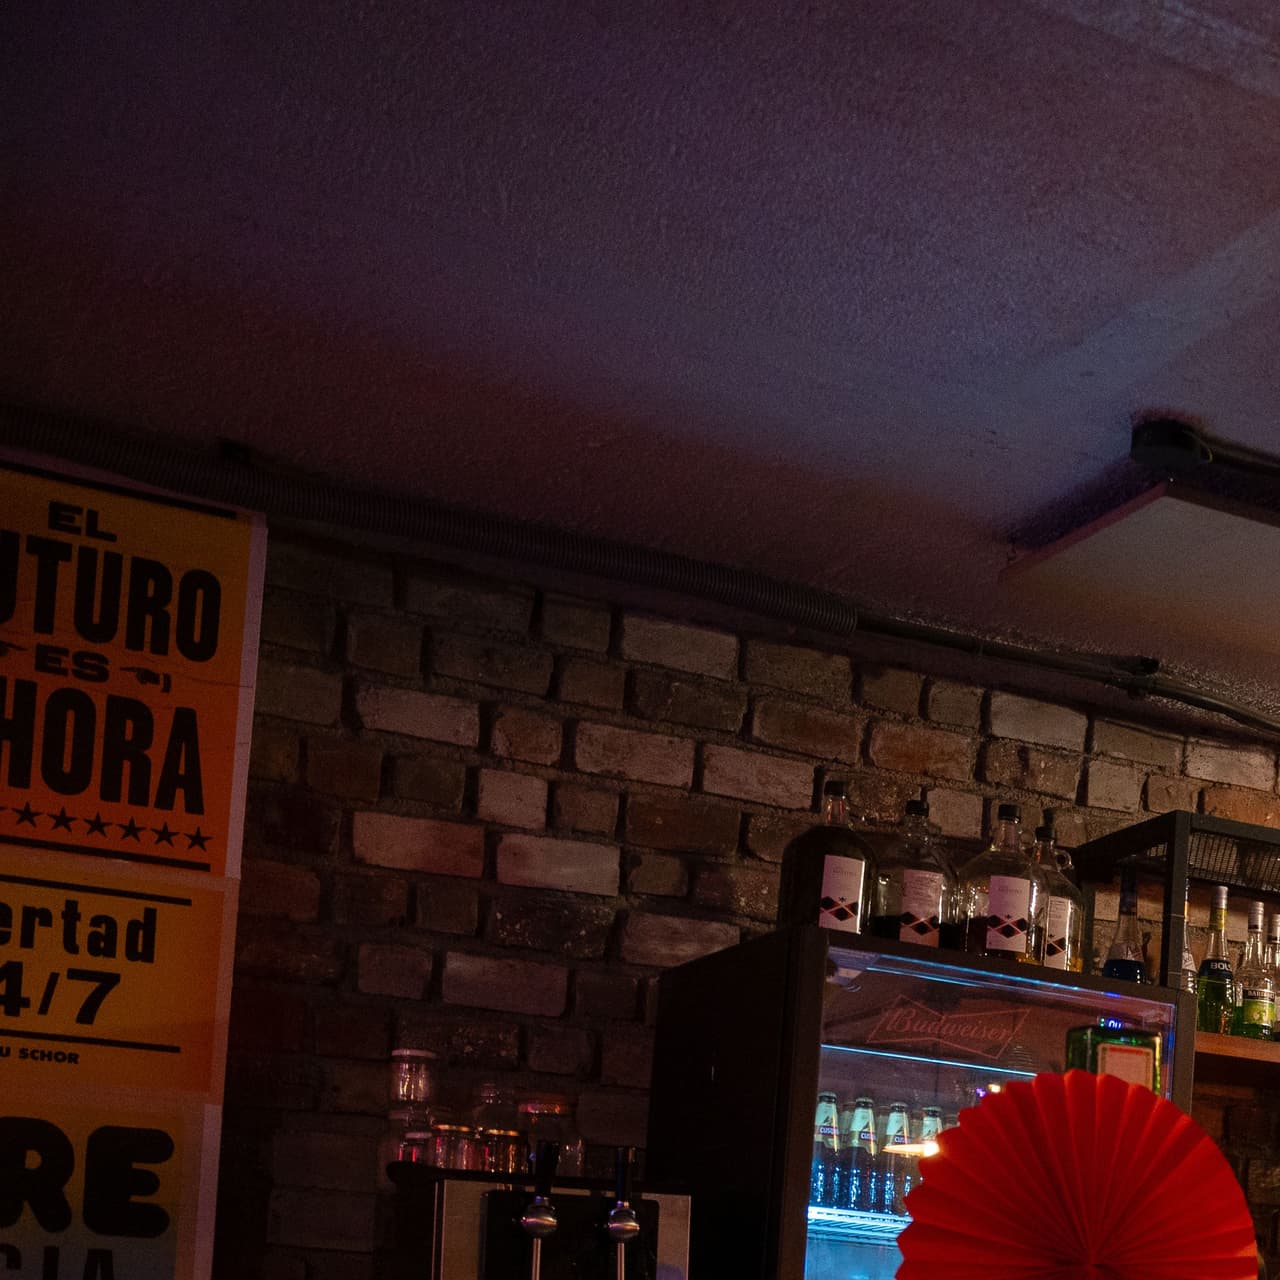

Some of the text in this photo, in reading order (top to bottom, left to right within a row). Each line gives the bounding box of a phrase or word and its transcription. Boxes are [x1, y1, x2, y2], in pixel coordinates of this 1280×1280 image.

[49, 501, 117, 541] EL
[35, 643, 109, 682] ES
[885, 1007, 1009, 1041] Budweiser
[19, 1047, 80, 1064] SCHOR
[0, 1116, 174, 1238] RE
